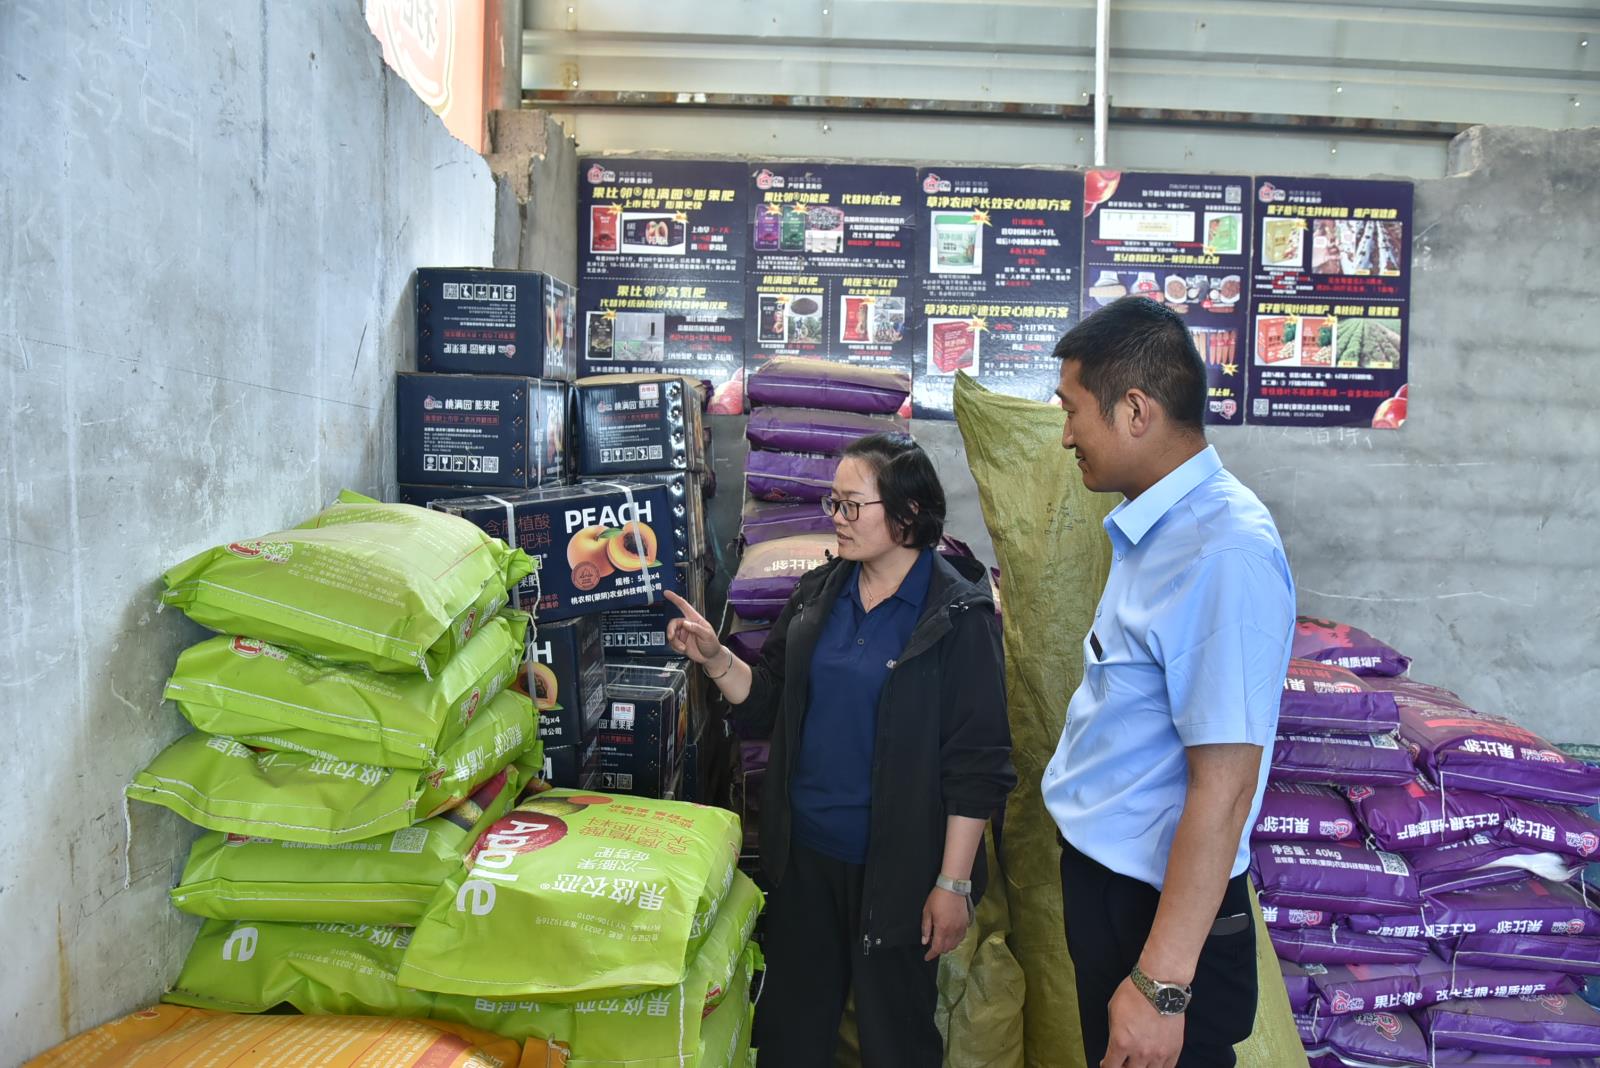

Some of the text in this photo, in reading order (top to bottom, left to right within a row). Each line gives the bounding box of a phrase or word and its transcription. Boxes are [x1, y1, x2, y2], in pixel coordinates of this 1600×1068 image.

[564, 500, 653, 534] PEACH
[456, 819, 550, 917] Apple
[1315, 848, 1343, 860] 40kg
